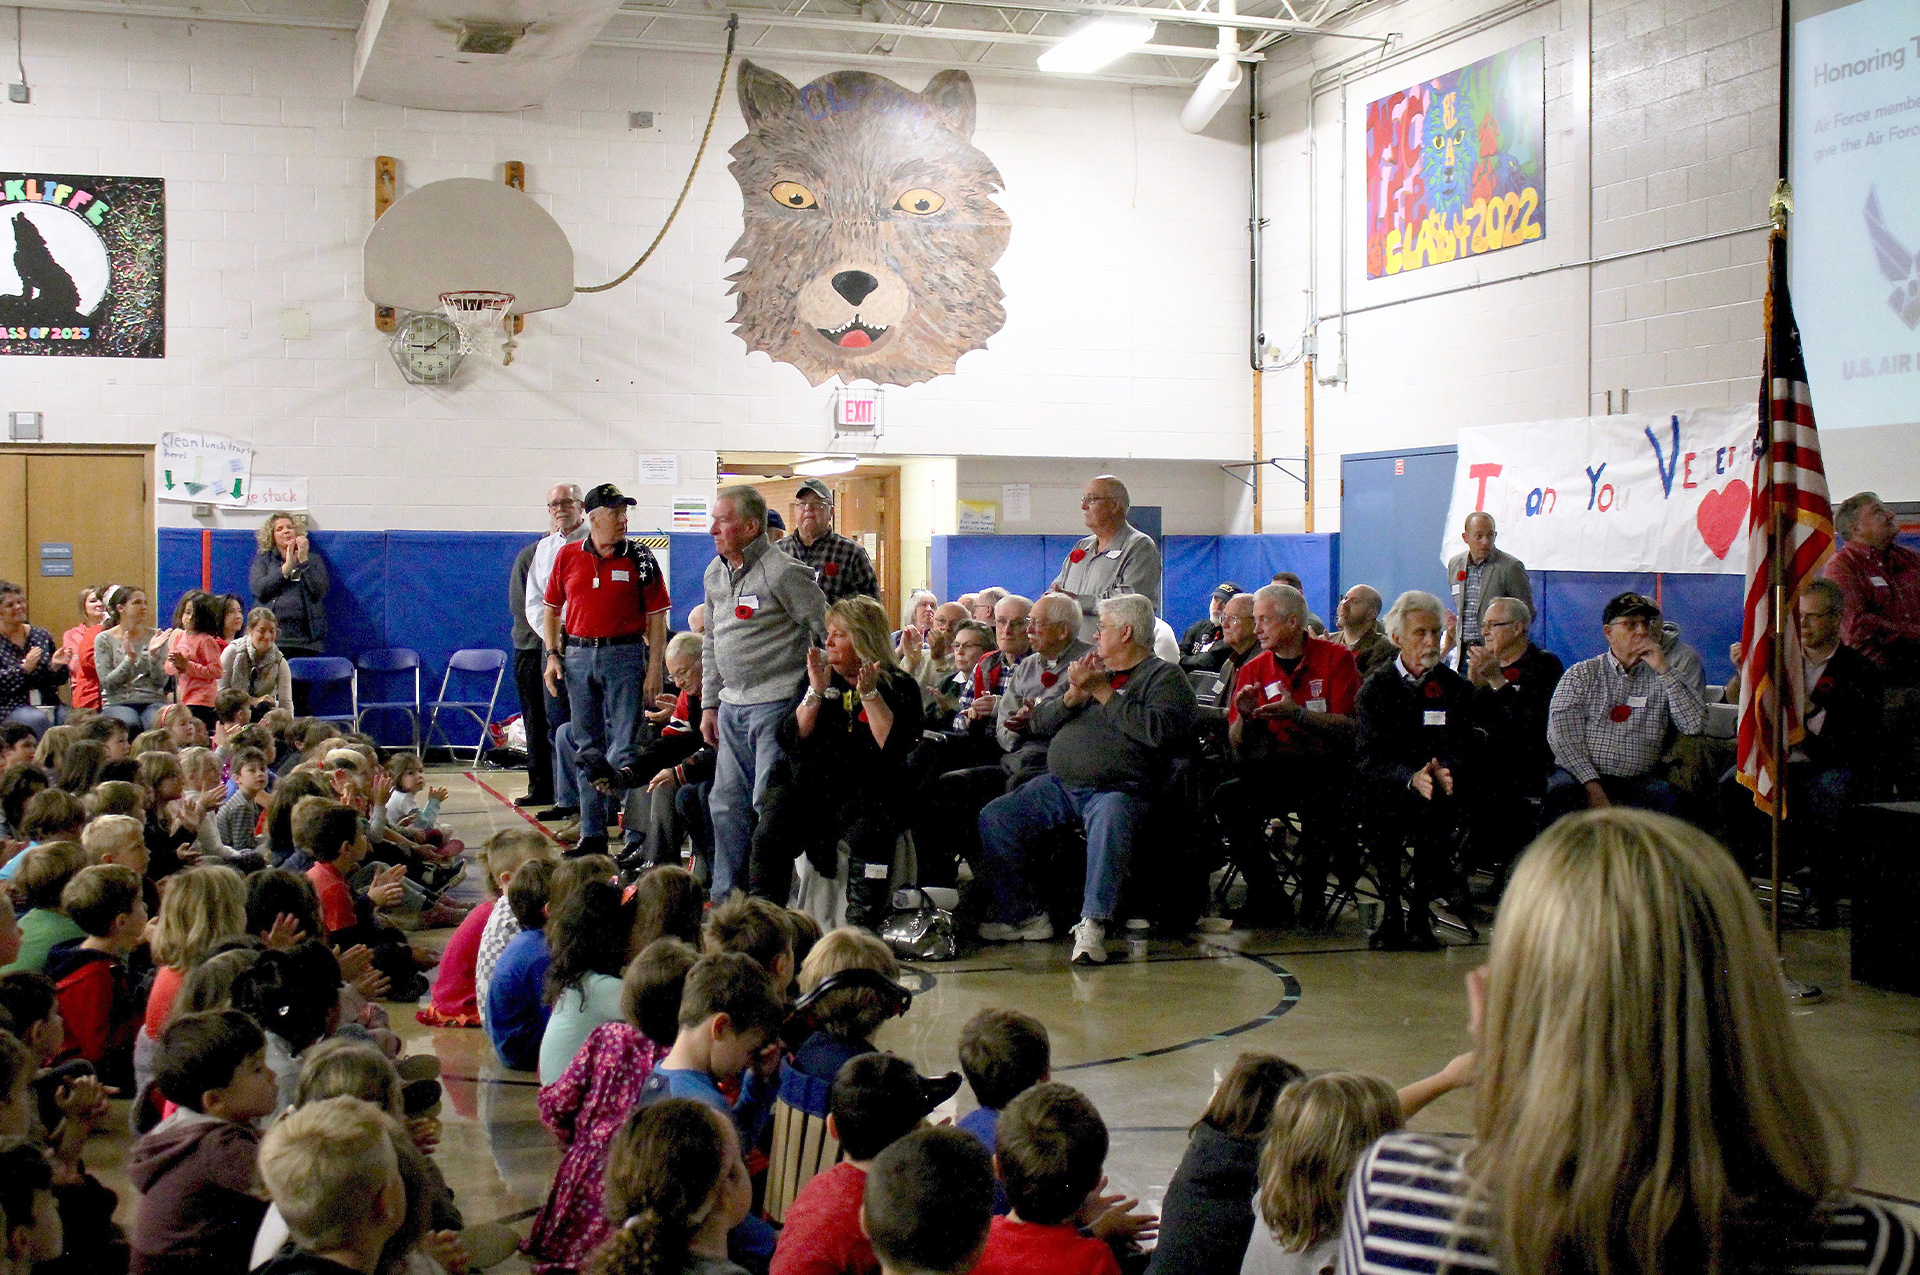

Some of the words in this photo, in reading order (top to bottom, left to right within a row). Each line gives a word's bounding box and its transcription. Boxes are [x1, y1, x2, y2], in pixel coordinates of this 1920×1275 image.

[1814, 47, 1906, 87] Honoring
[1813, 120, 1832, 134] Air
[1834, 112, 1871, 129] Force
[1814, 145, 1837, 163] give
[1841, 138, 1861, 152] the
[1865, 131, 1885, 147] Air
[1465, 187, 1542, 254] 2022
[29, 327, 50, 340] OF
[1878, 353, 1911, 375] AIR
[845, 400, 874, 423] EXIT
[162, 432, 198, 448] Clean
[201, 437, 226, 451] lunch
[228, 442, 251, 454] trays
[1469, 462, 1560, 522] Than
[1585, 461, 1631, 513] You
